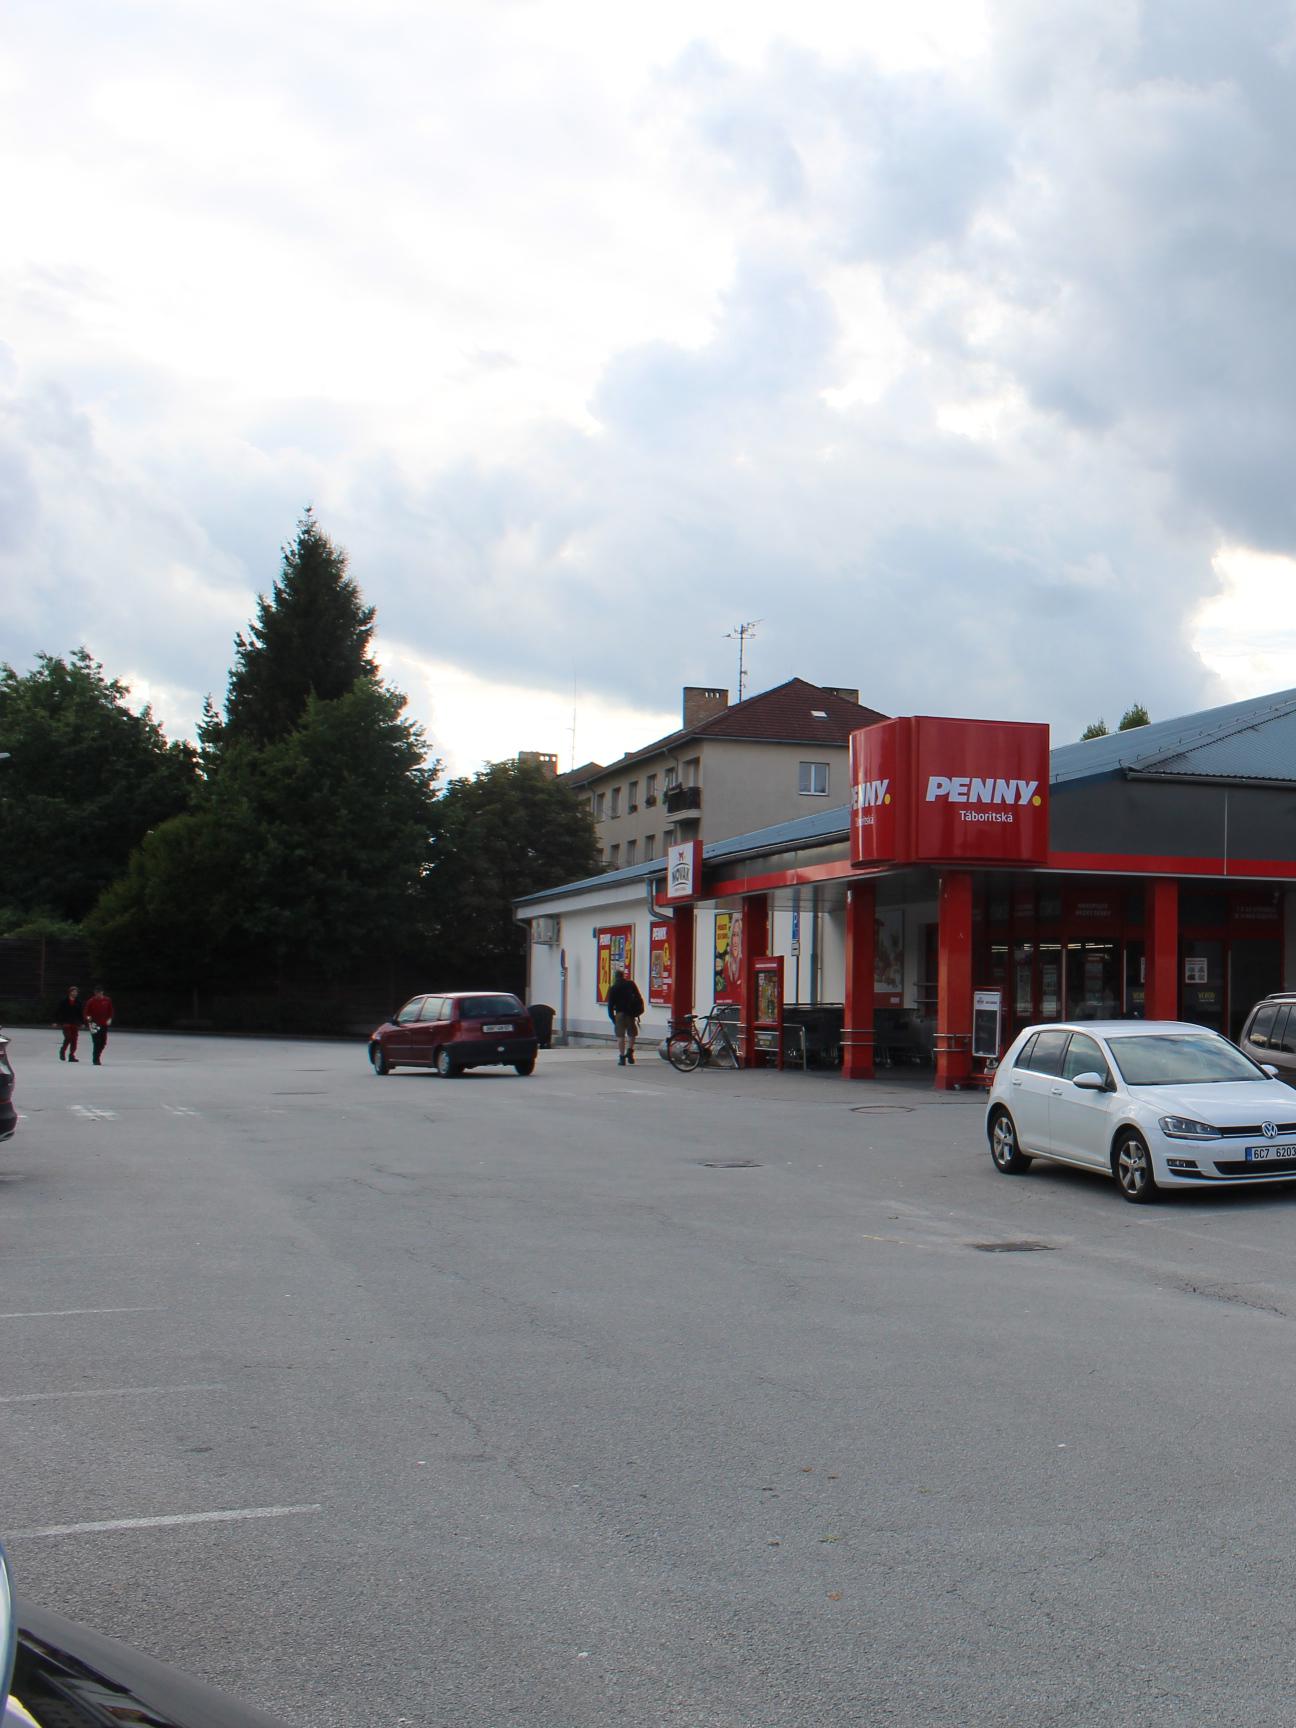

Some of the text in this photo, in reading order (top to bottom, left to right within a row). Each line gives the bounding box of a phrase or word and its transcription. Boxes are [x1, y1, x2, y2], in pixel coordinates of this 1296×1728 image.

[959, 810, 1013, 823] Táboritská
[1253, 1147, 1296, 1159] 6C7 6203
